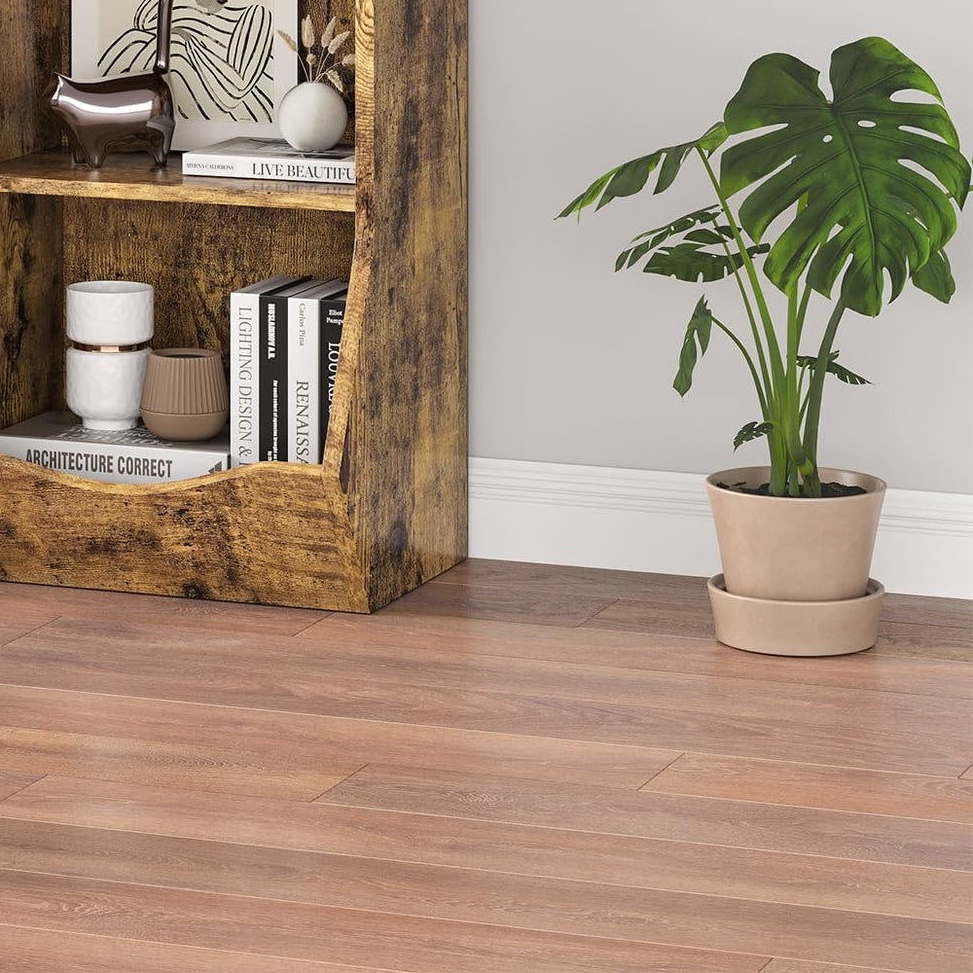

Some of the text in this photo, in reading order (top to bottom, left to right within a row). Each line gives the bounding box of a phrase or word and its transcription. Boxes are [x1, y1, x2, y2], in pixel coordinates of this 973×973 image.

[252, 162, 284, 177] LIVE
[326, 317, 344, 325] Pamp
[239, 307, 252, 381] LIGHTING
[239, 385, 252, 442] DESIGN
[238, 445, 252, 457] &
[26, 449, 173, 477] ARCHITECTURE CORRECT
